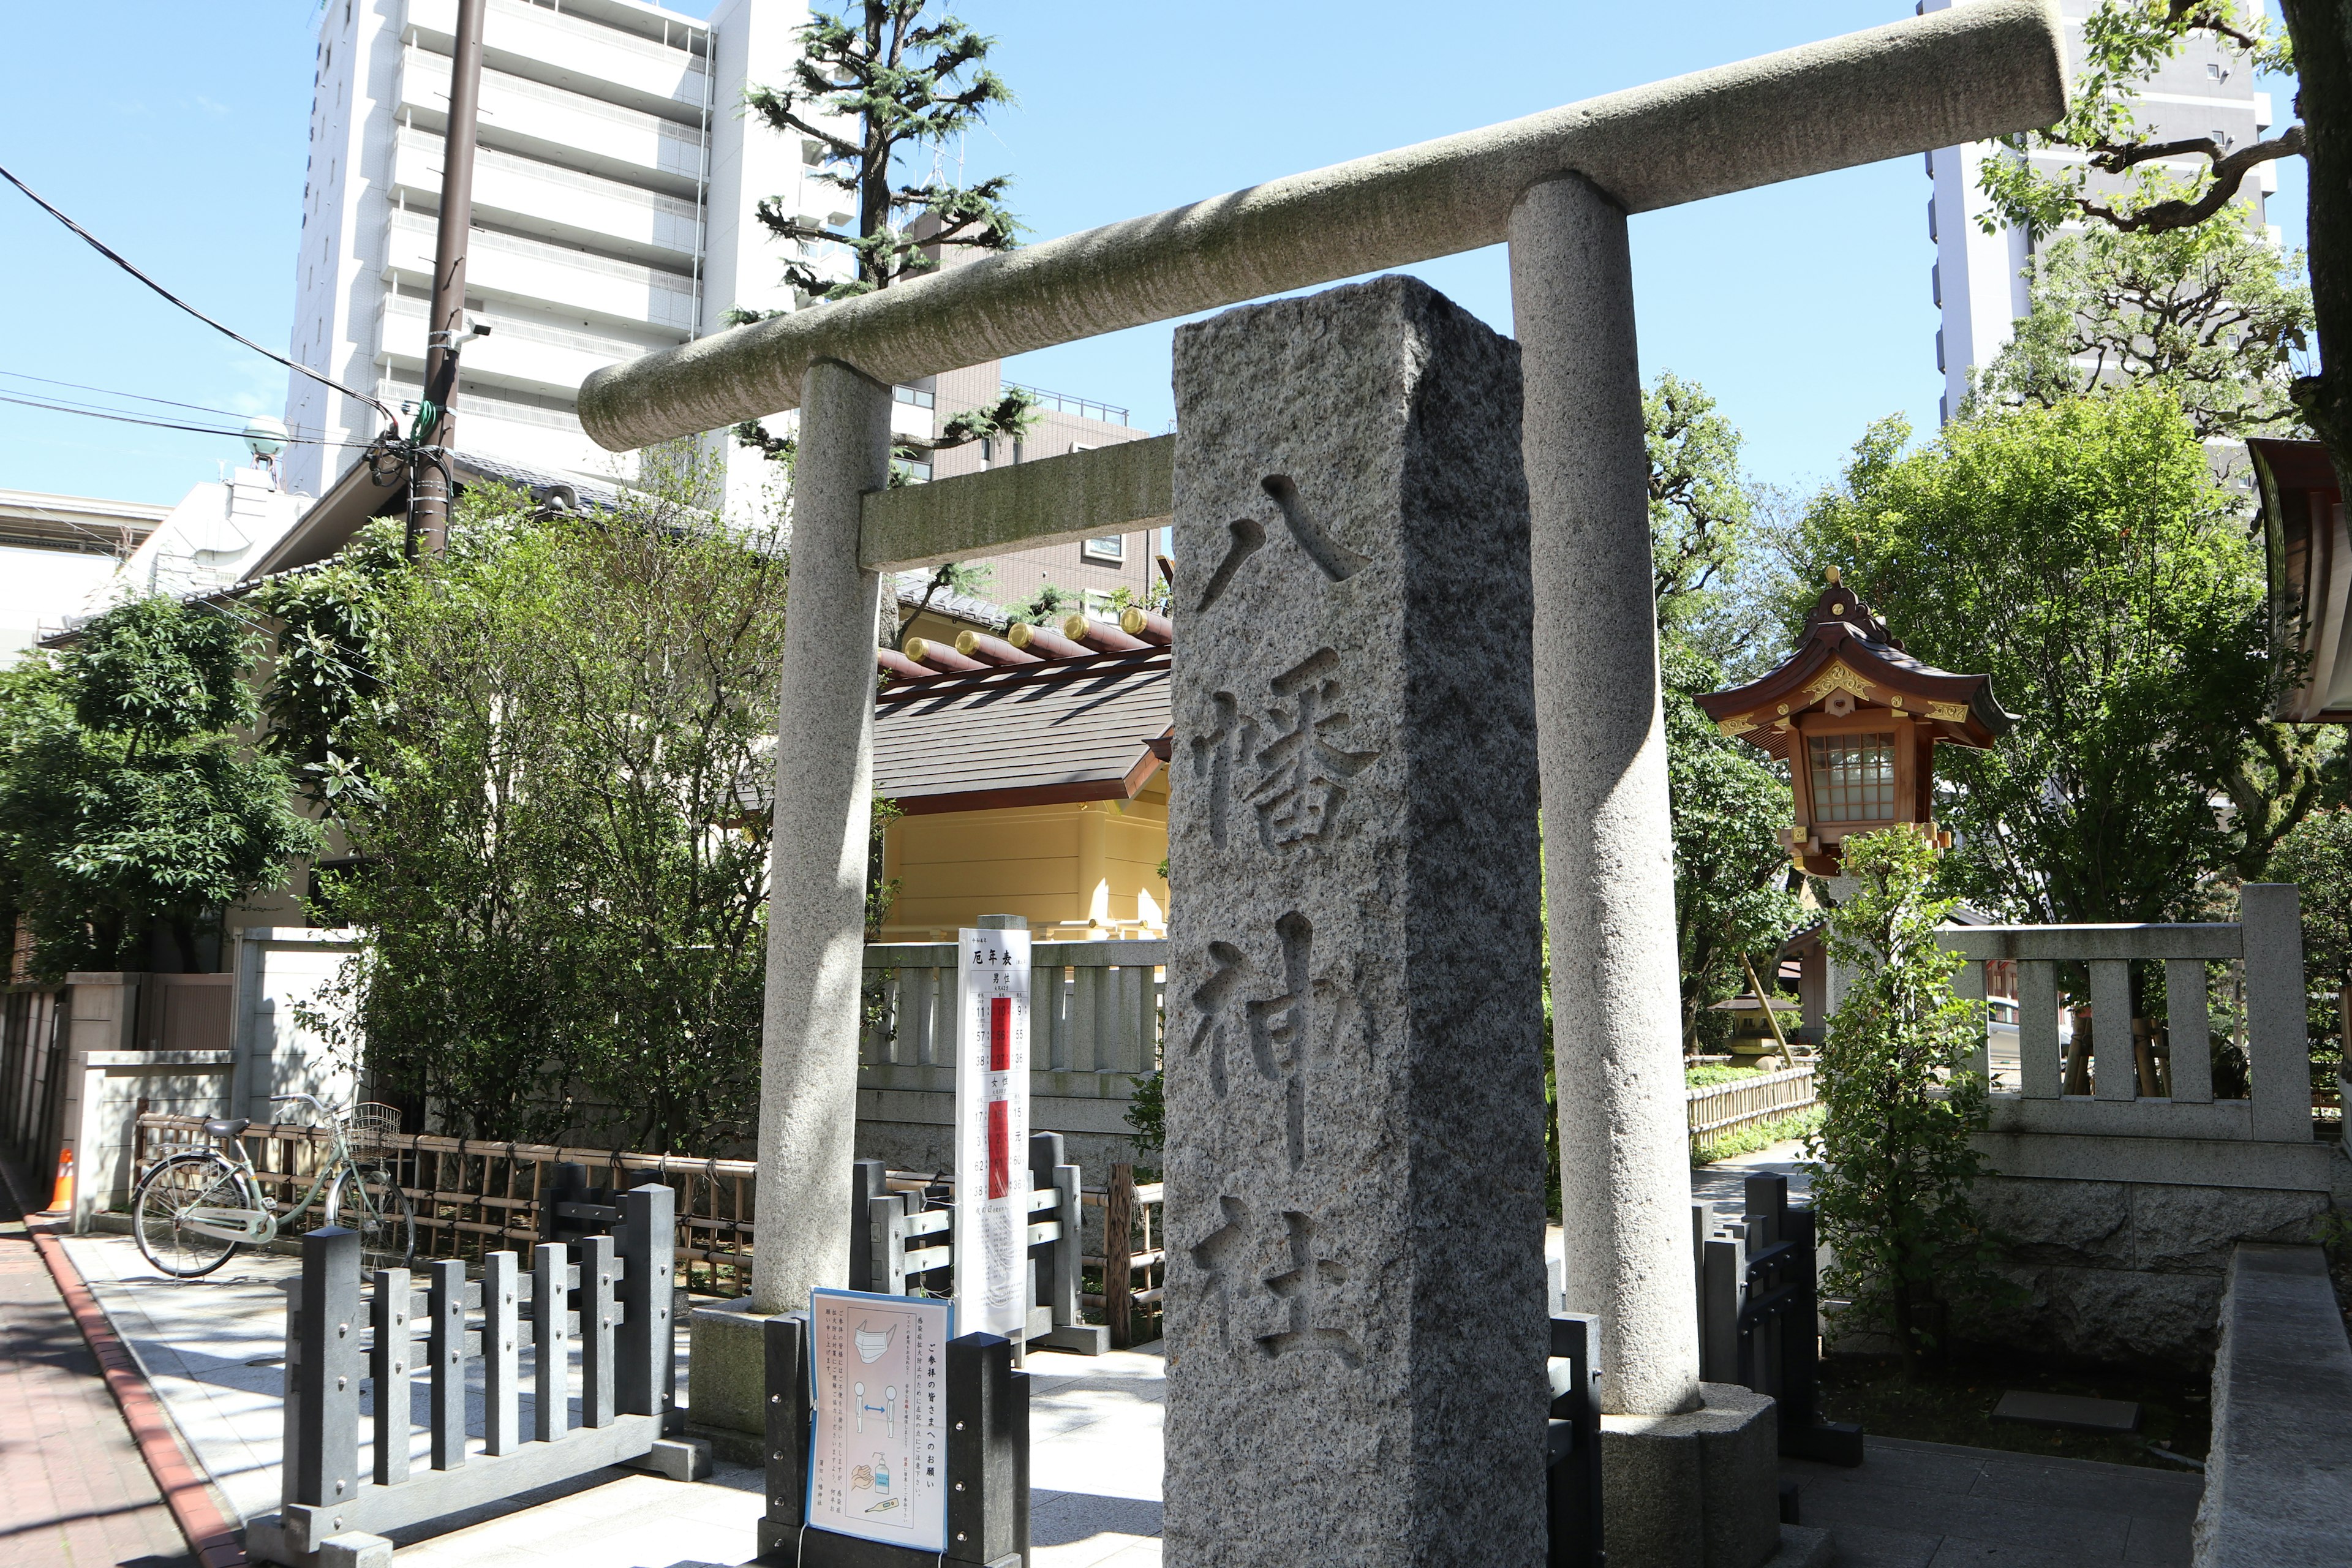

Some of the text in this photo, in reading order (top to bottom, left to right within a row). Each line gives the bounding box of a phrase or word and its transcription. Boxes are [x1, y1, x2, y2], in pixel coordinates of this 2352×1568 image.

[1189, 473, 1380, 1371] 八幡神社
[972, 948, 1012, 966] 厄年表
[992, 973, 1011, 984] 男性
[976, 1006, 985, 1017] 11
[998, 1006, 1006, 1017] 10
[1017, 1006, 1022, 1016] 9
[976, 1031, 985, 1042] 57
[997, 1030, 1005, 1040] 56
[1016, 1029, 1023, 1039] 55
[976, 1055, 985, 1066] 38
[997, 1054, 1005, 1065] 37
[1016, 1054, 1023, 1063] 36
[991, 1075, 1008, 1088] 女性
[974, 1112, 983, 1123] 17
[1014, 1107, 1022, 1118] 15
[976, 1136, 981, 1147] 3
[997, 1134, 1000, 1144] 2
[1015, 1131, 1021, 1142] 元
[974, 1160, 984, 1171] 62
[1013, 1155, 1021, 1165] 60
[974, 1186, 983, 1197] 38
[926, 1343, 937, 1488] ご参拝の皆さまへのお願い
